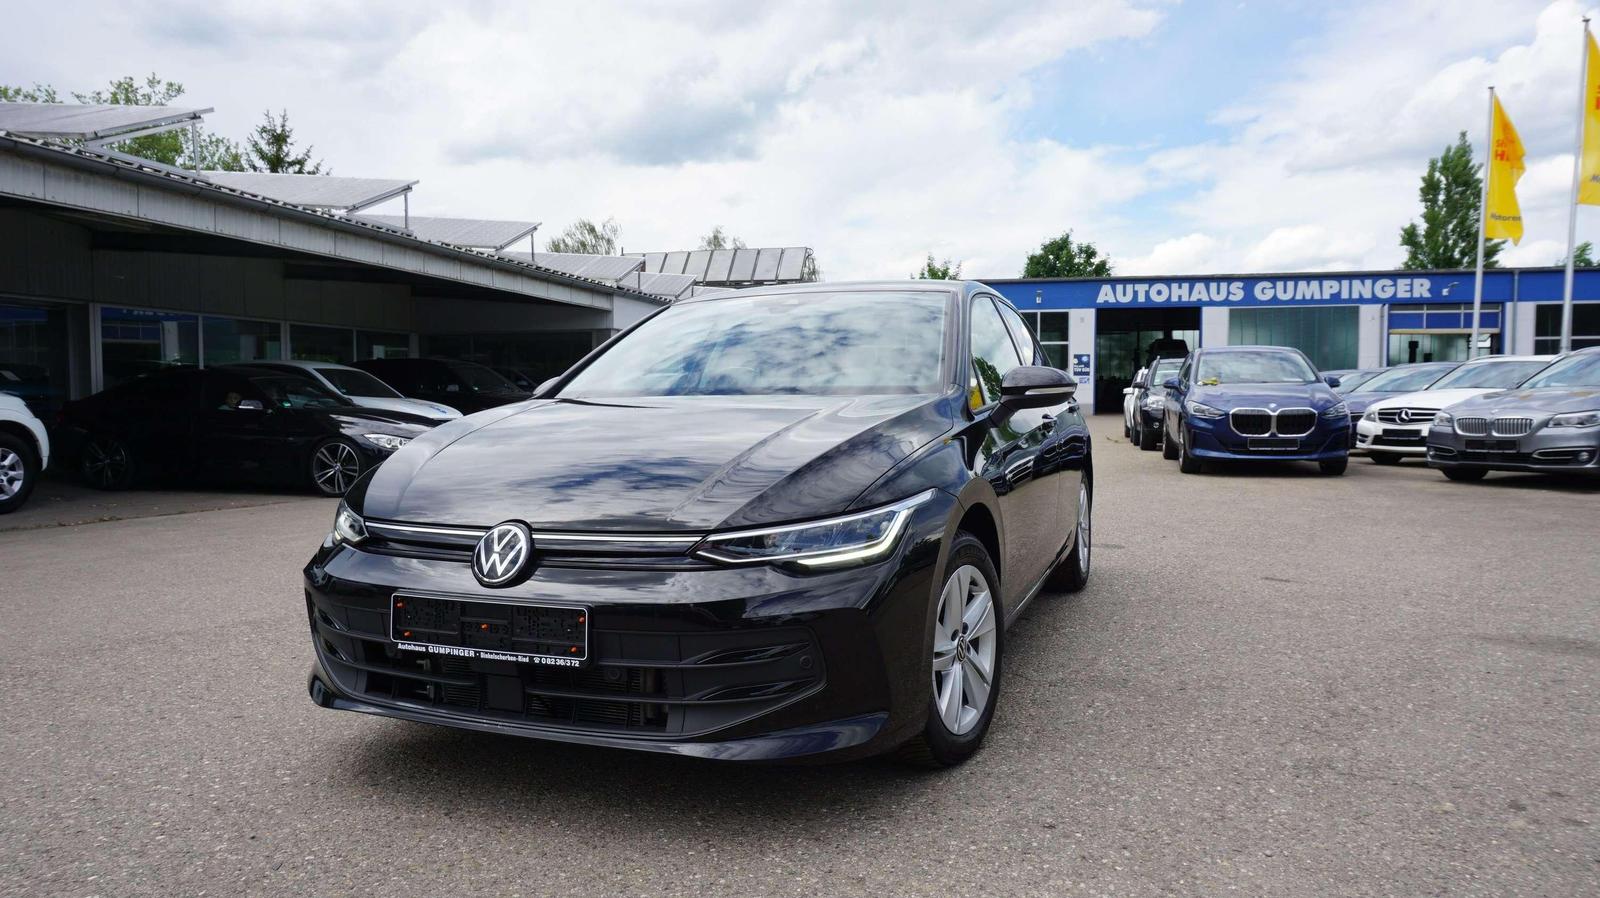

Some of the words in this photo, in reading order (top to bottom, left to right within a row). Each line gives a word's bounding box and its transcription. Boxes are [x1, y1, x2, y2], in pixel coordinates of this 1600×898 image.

[1097, 283, 1244, 303] AUTOHAUS
[1254, 279, 1431, 300] GUMPINGER
[398, 643, 426, 652] Autohaus
[428, 646, 475, 657] GUMPINGER
